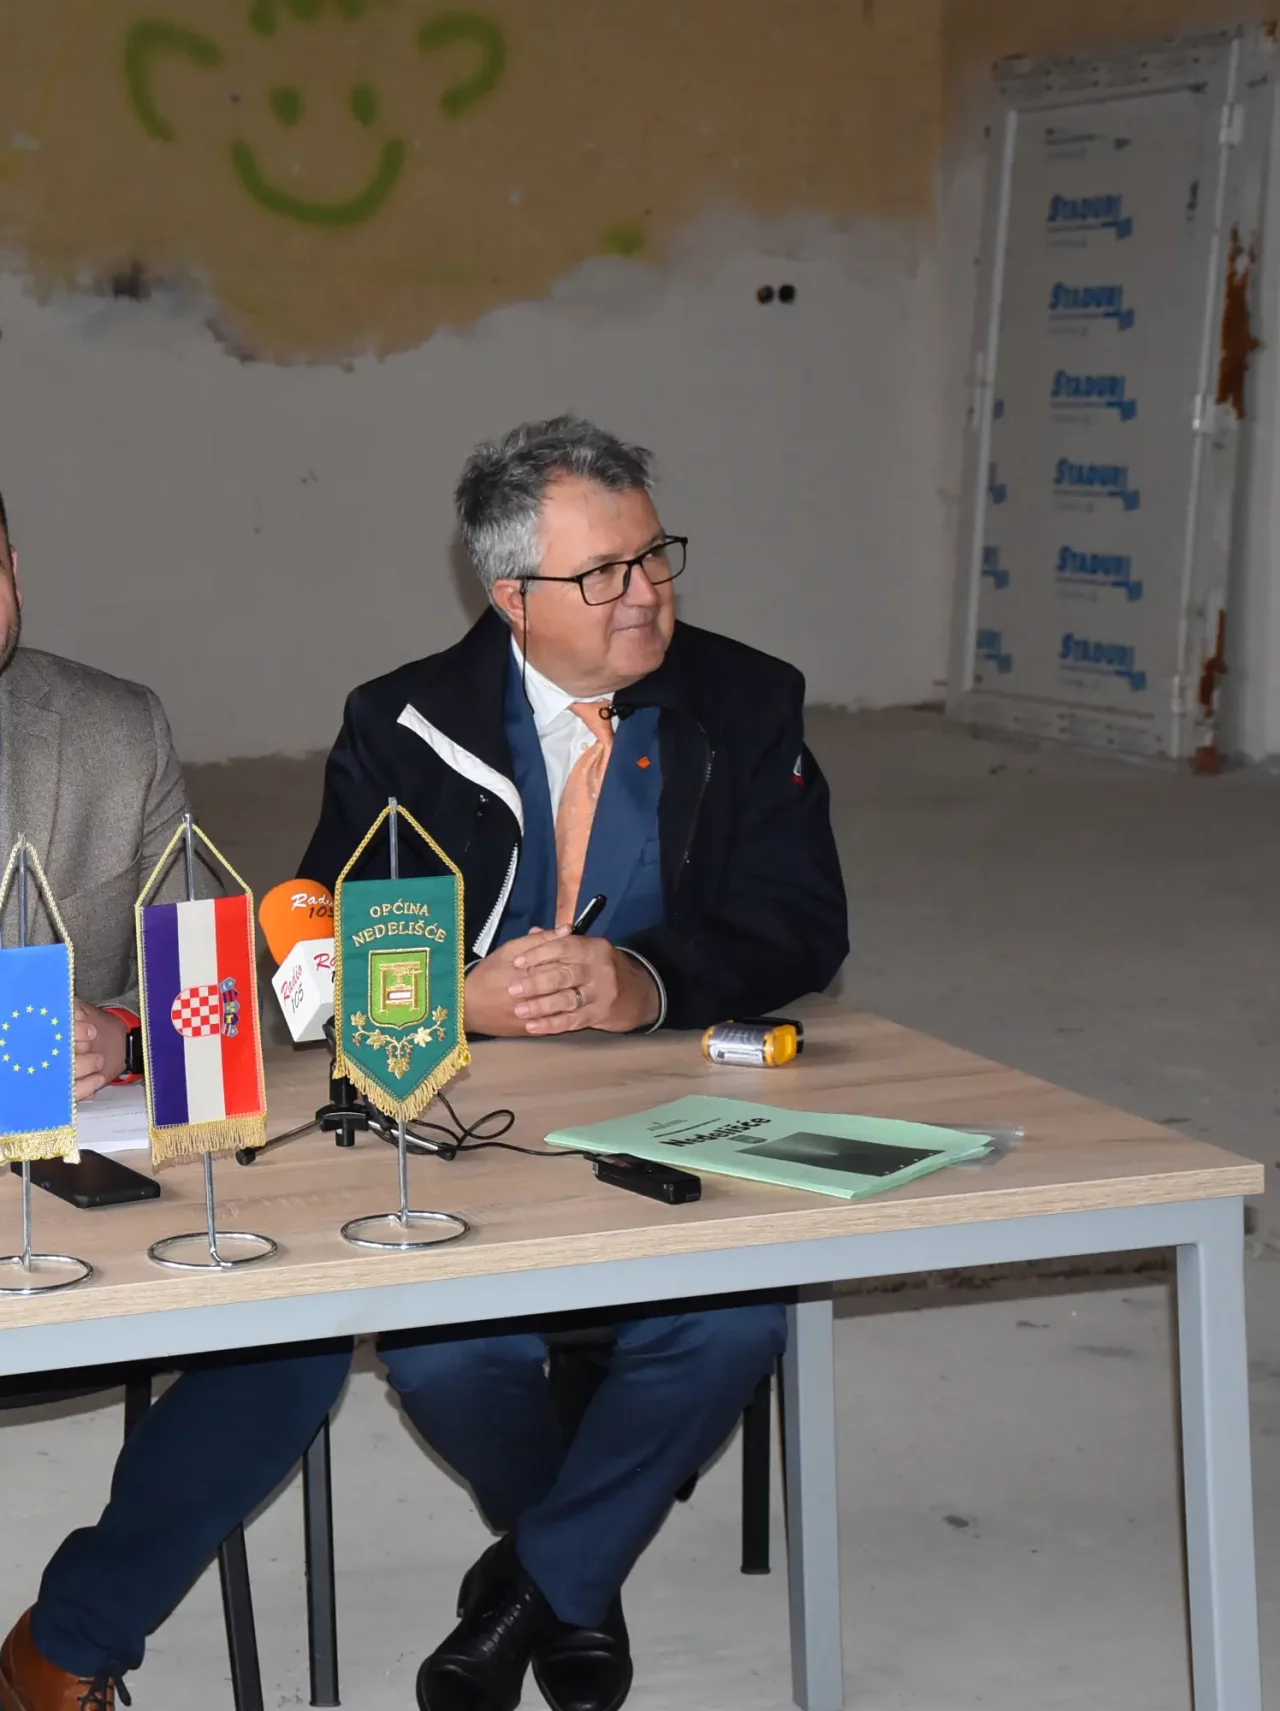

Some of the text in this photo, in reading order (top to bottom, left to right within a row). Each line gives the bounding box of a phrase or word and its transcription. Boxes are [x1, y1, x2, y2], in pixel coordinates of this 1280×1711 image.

[369, 898, 430, 918] OPĆINA
[351, 919, 447, 947] NEDELIŠĆE
[280, 964, 303, 1006] Radio
[291, 983, 304, 1013] 105
